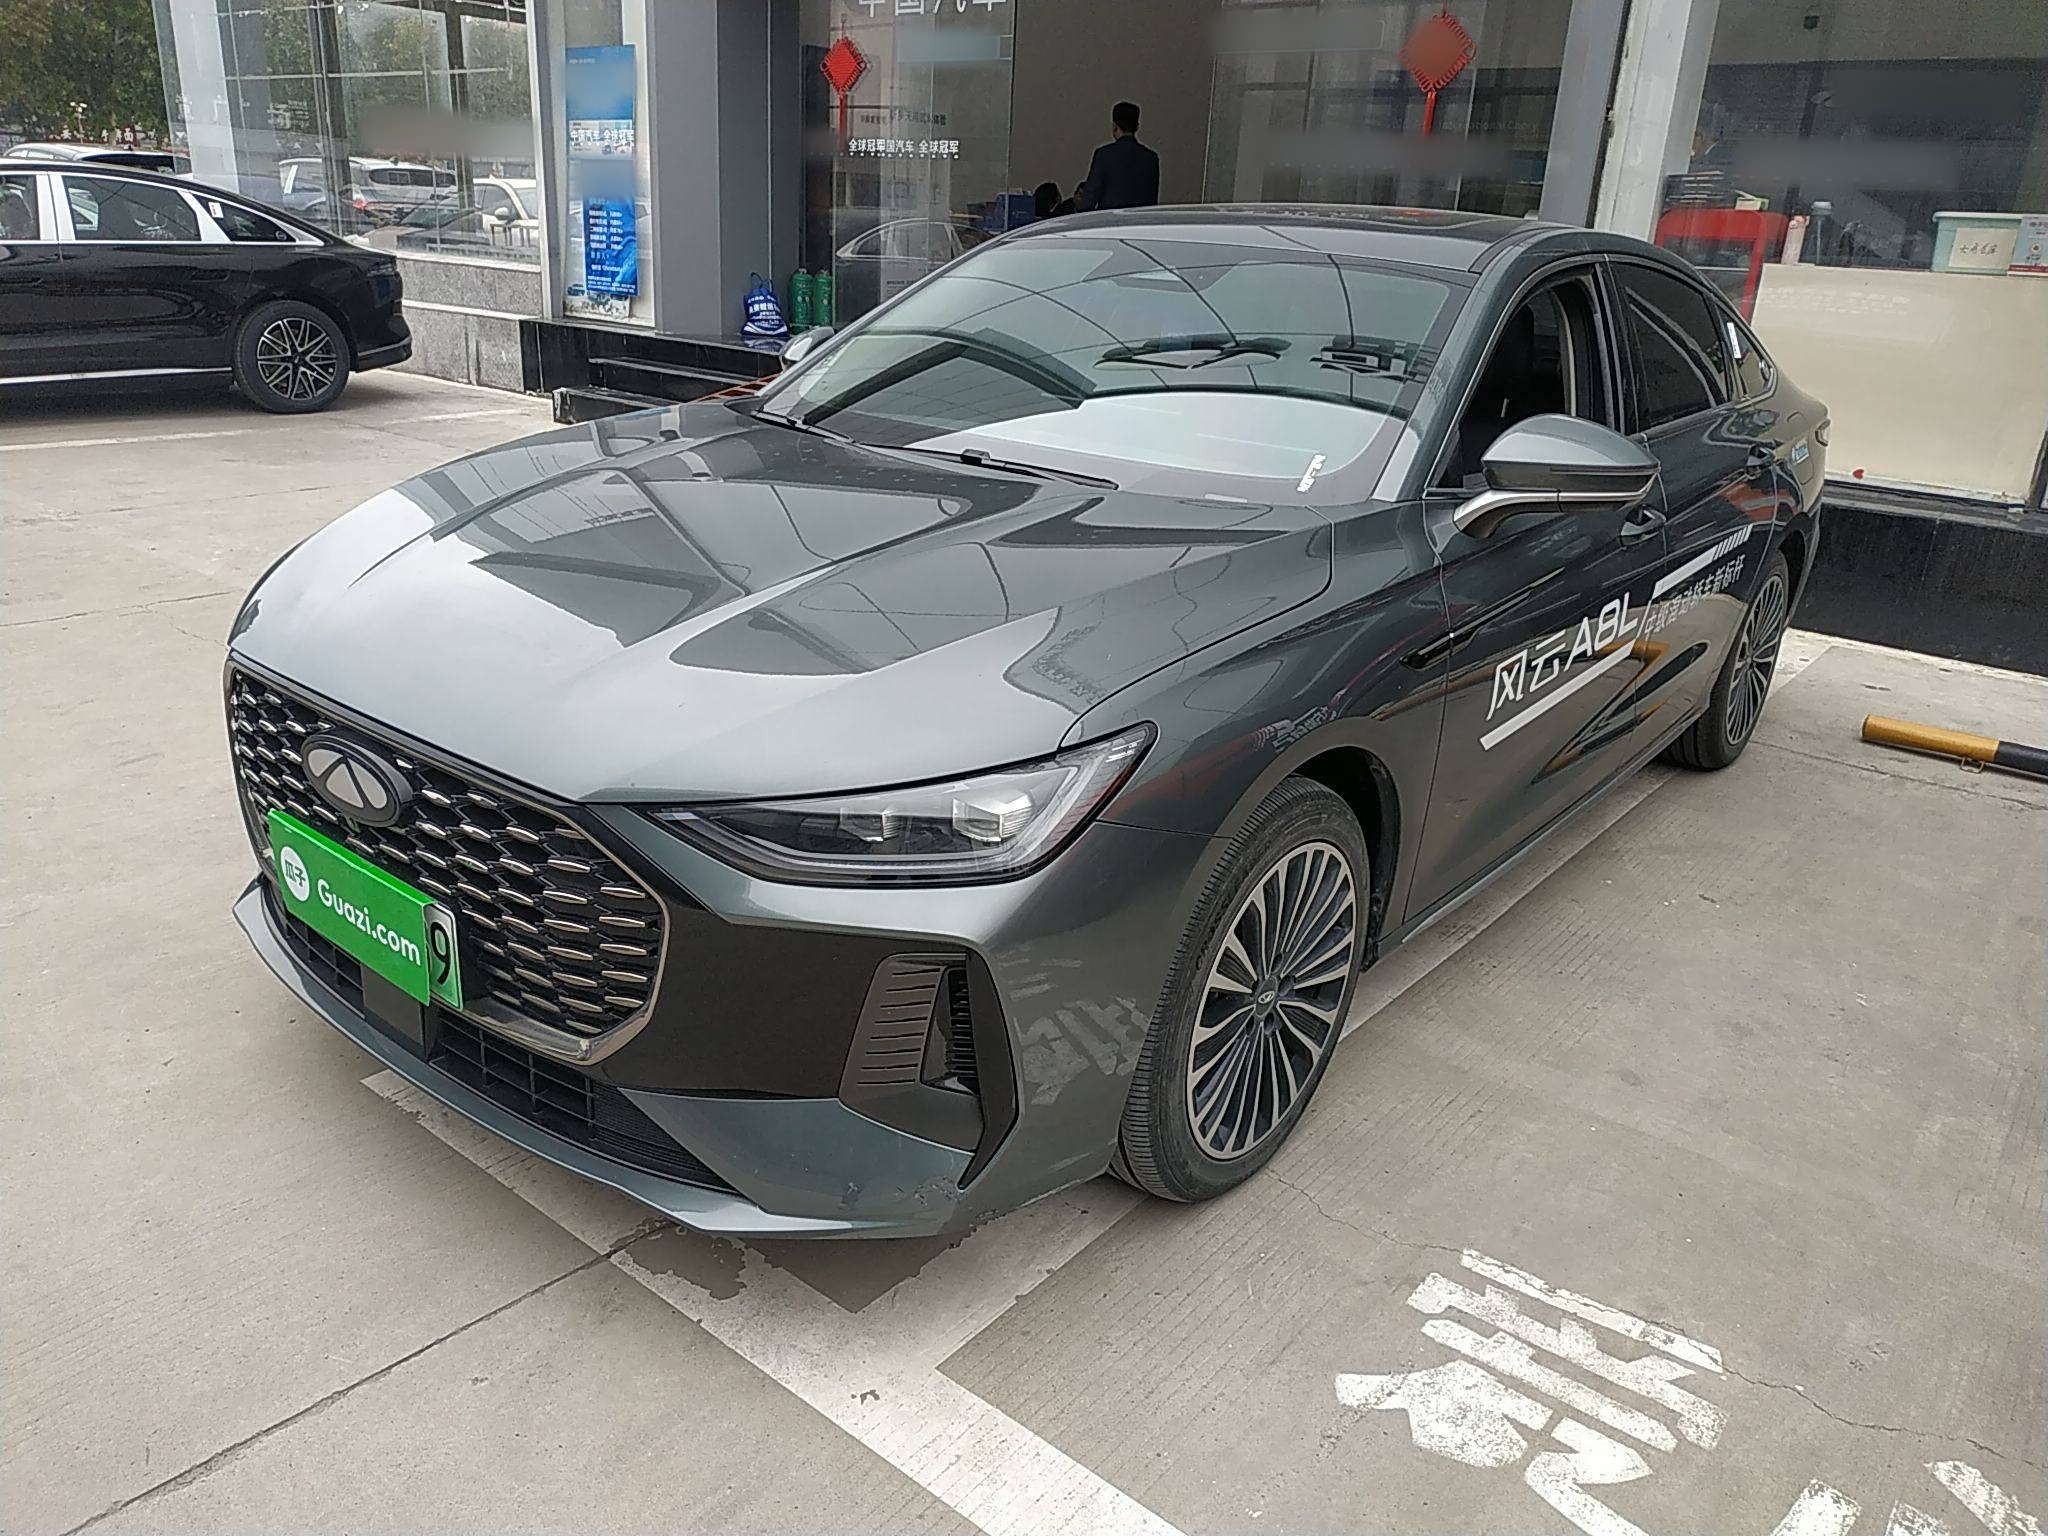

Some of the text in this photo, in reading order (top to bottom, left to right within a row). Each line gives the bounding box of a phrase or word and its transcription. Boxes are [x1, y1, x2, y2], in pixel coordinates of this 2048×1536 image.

[918, 140, 959, 154] 全球冠军
[1486, 591, 1639, 721] 风云A8L
[317, 879, 421, 966] Guazi.com
[430, 922, 451, 985] 9
